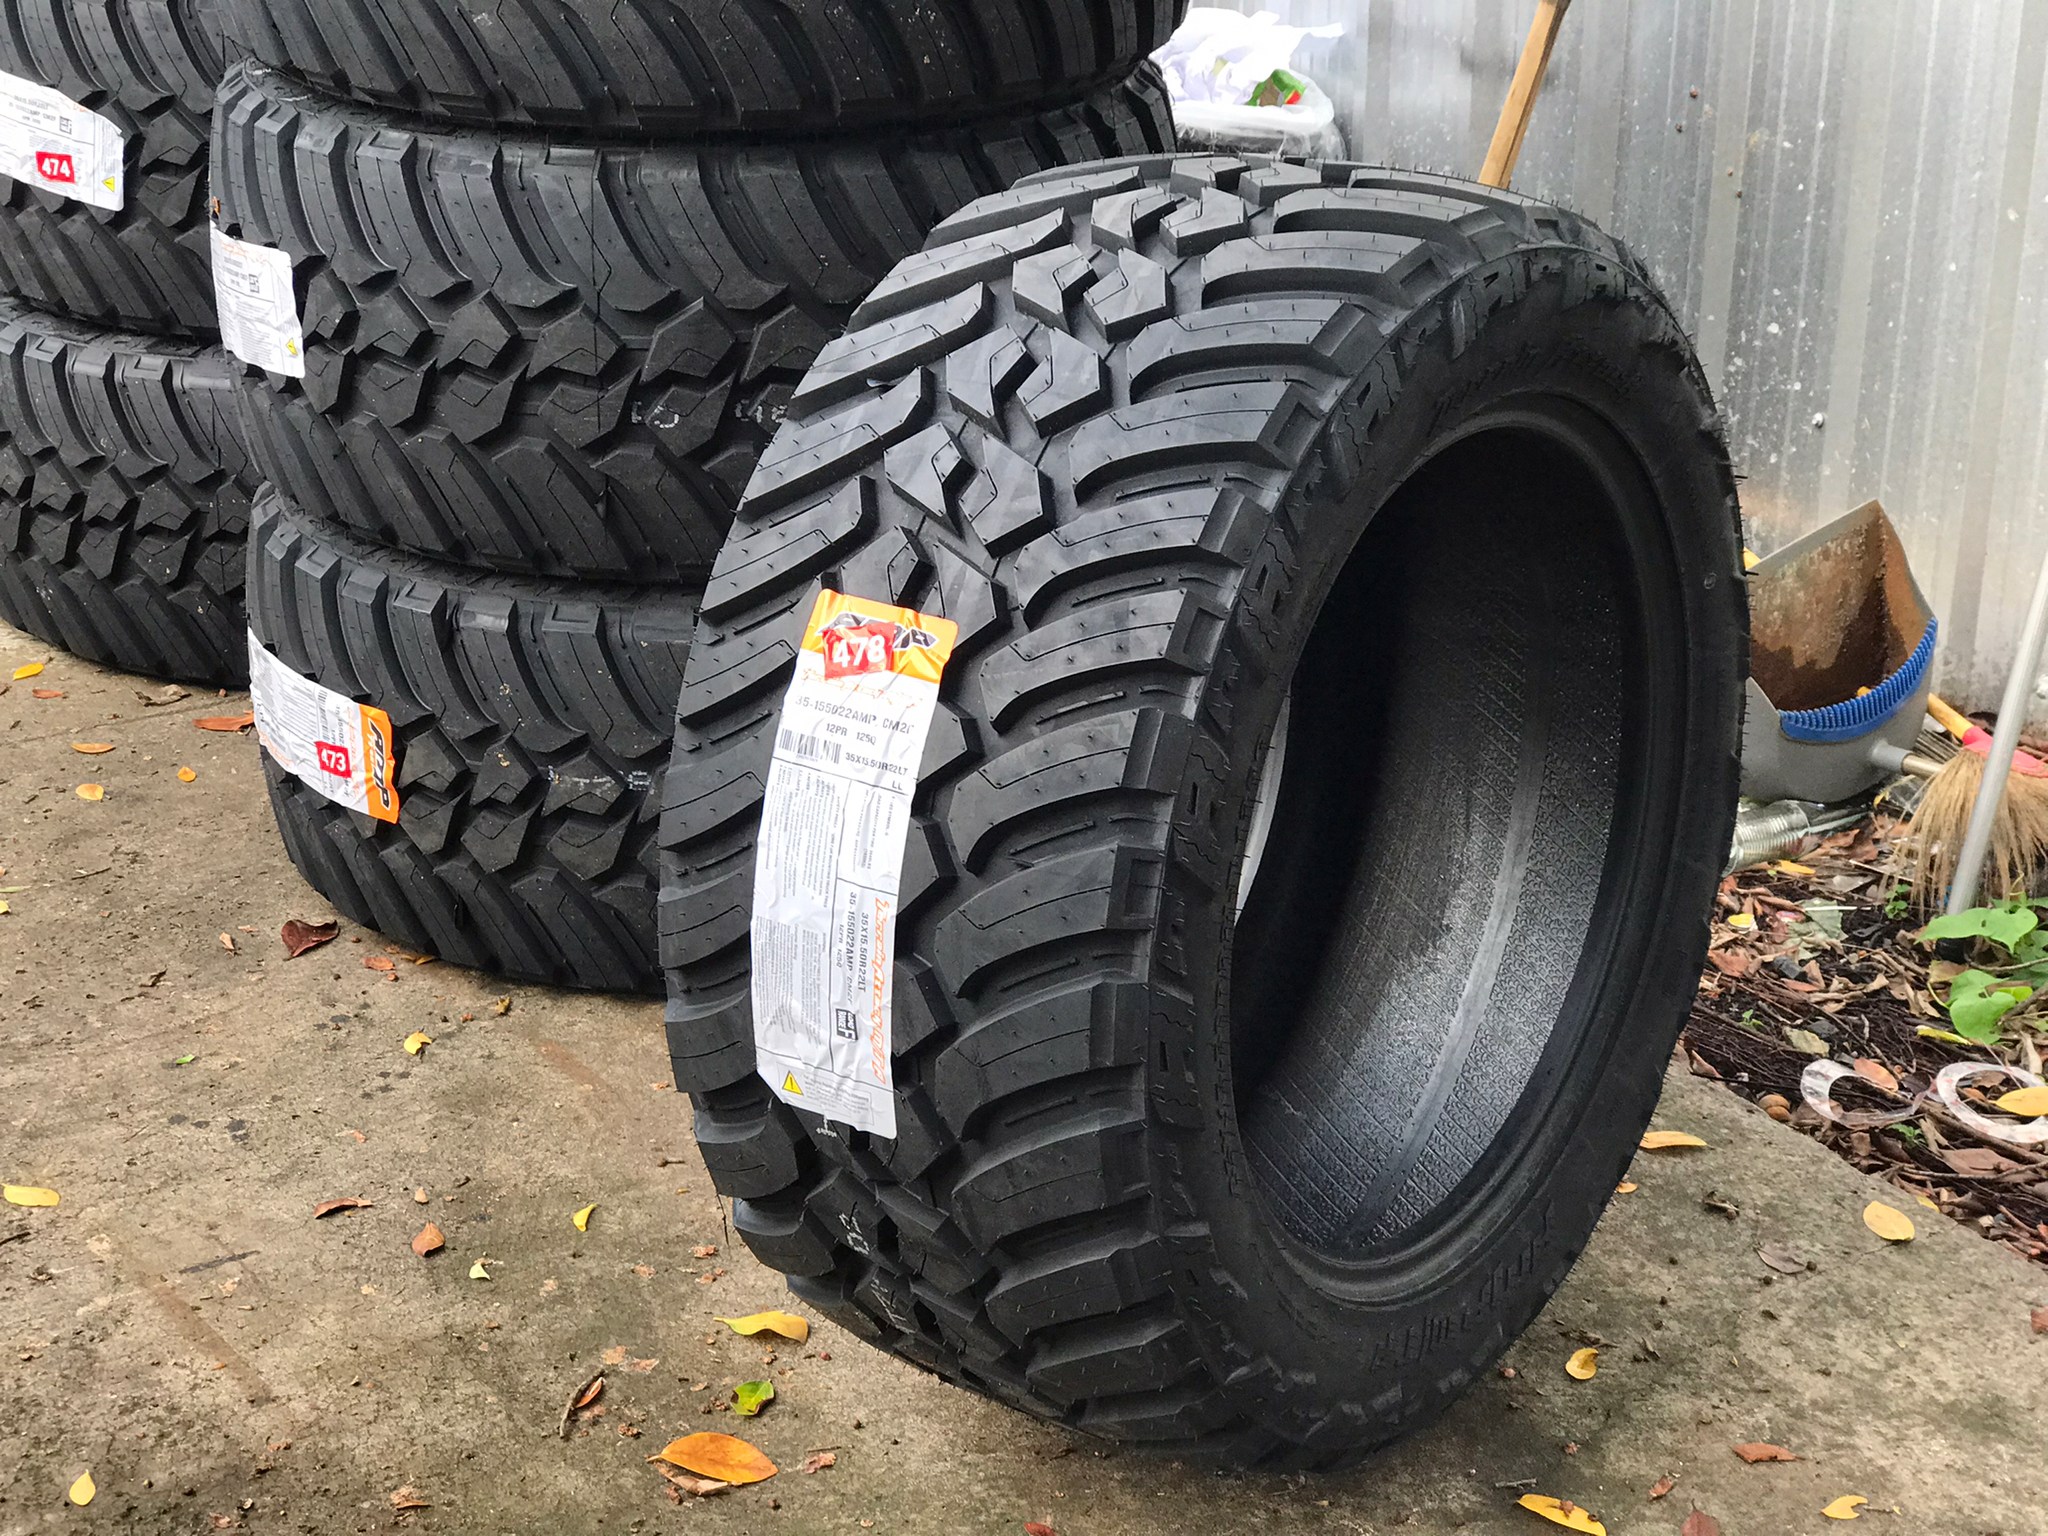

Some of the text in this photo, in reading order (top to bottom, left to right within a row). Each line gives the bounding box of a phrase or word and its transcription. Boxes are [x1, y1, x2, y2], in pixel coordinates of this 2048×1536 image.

[41, 157, 71, 178] 474
[832, 636, 886, 668] 478
[826, 723, 848, 737] 12PR
[321, 748, 347, 772] 473
[858, 912, 869, 993] 35X15.50R22LT
[838, 1027, 857, 1041] F
